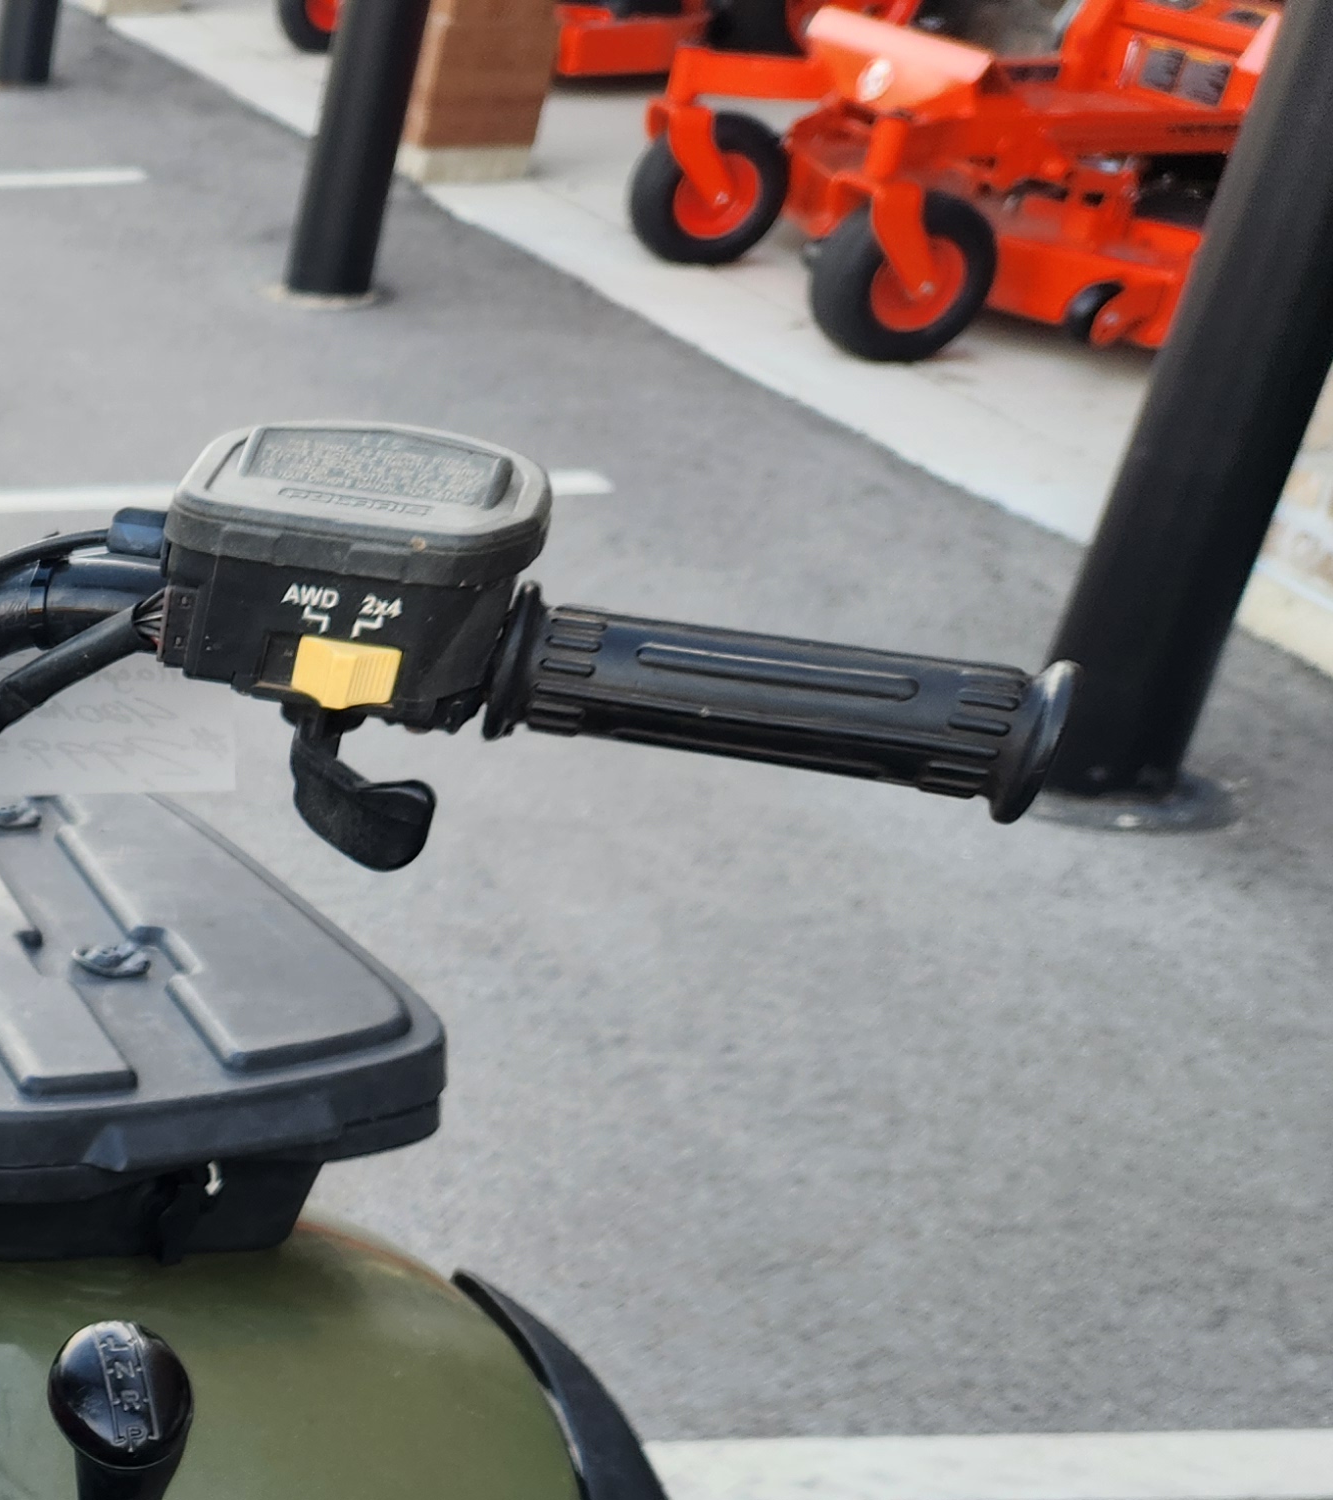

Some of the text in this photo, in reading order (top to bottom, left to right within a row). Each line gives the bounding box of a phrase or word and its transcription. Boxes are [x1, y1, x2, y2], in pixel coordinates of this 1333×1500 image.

[280, 582, 340, 609] AWD
[115, 1361, 136, 1378] N
[121, 1390, 140, 1411] R
[126, 1425, 147, 1452] P
